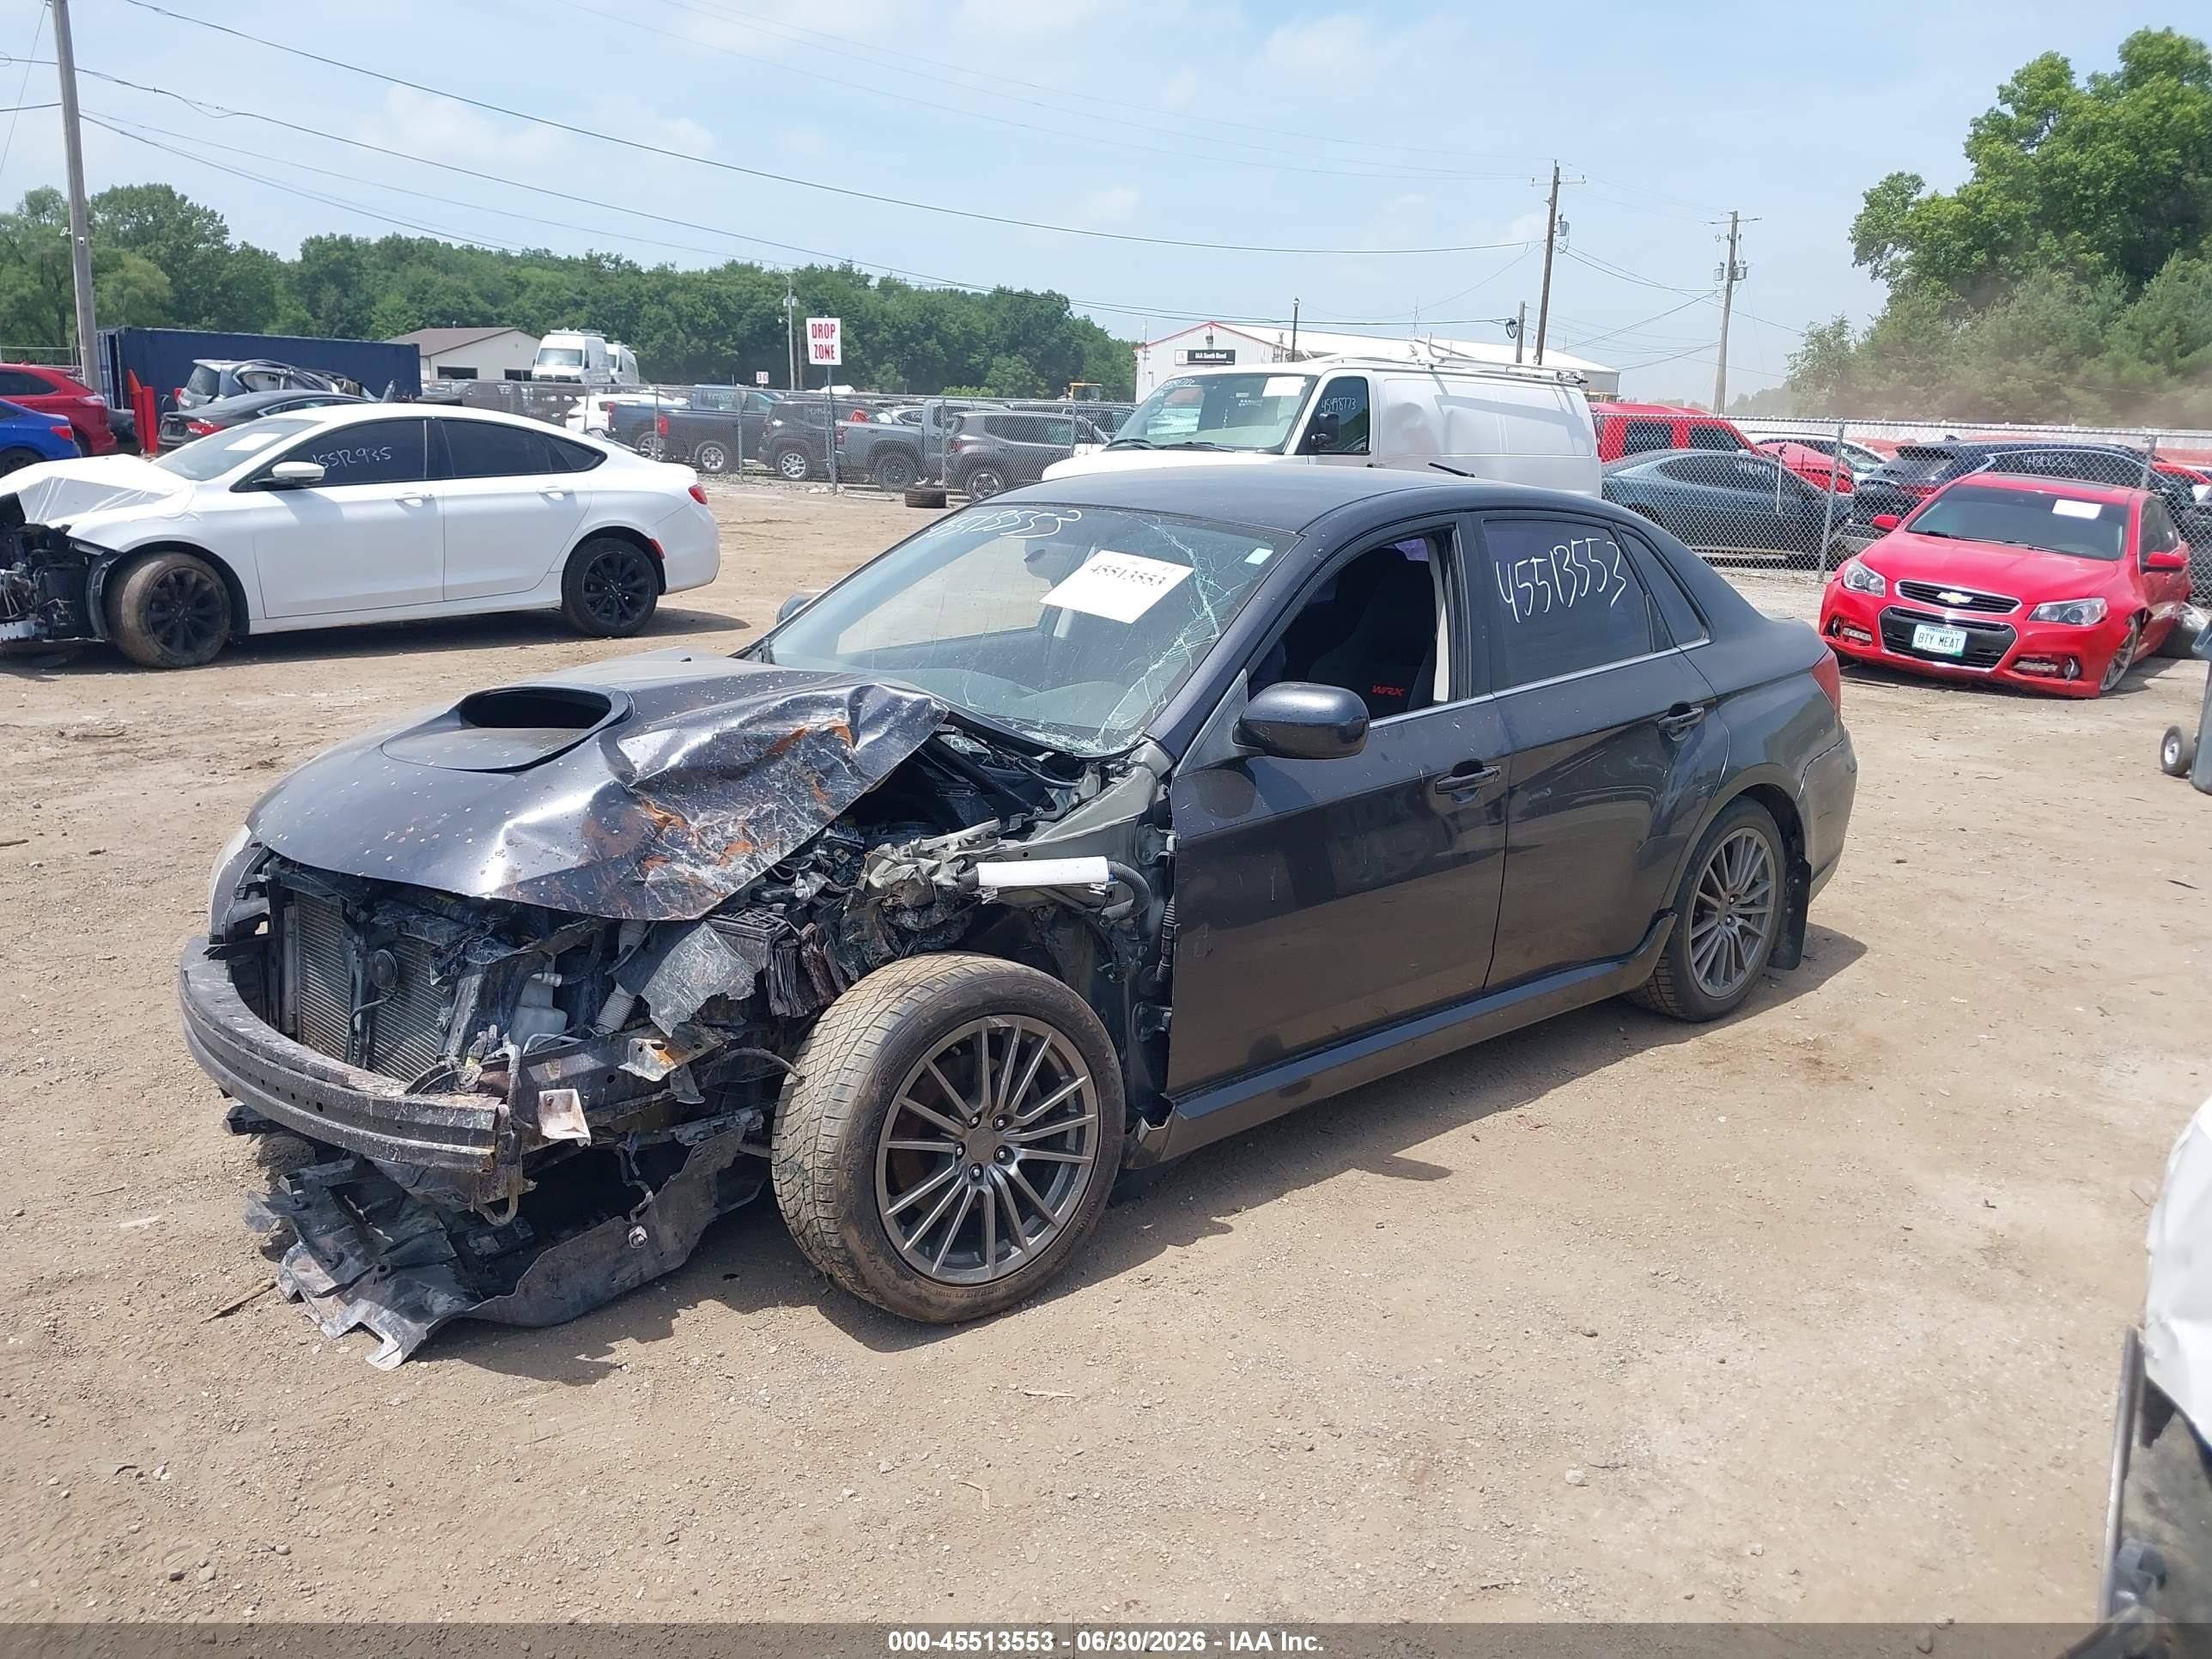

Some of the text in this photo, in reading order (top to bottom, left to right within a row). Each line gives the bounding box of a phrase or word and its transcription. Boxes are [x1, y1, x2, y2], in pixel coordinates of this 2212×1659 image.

[811, 323, 836, 339] DROP
[814, 344, 836, 360] ZONE
[1496, 538, 1627, 623] 45513553
[1917, 632, 1961, 649] BTY MEAT
[1372, 685, 1405, 696] WRX
